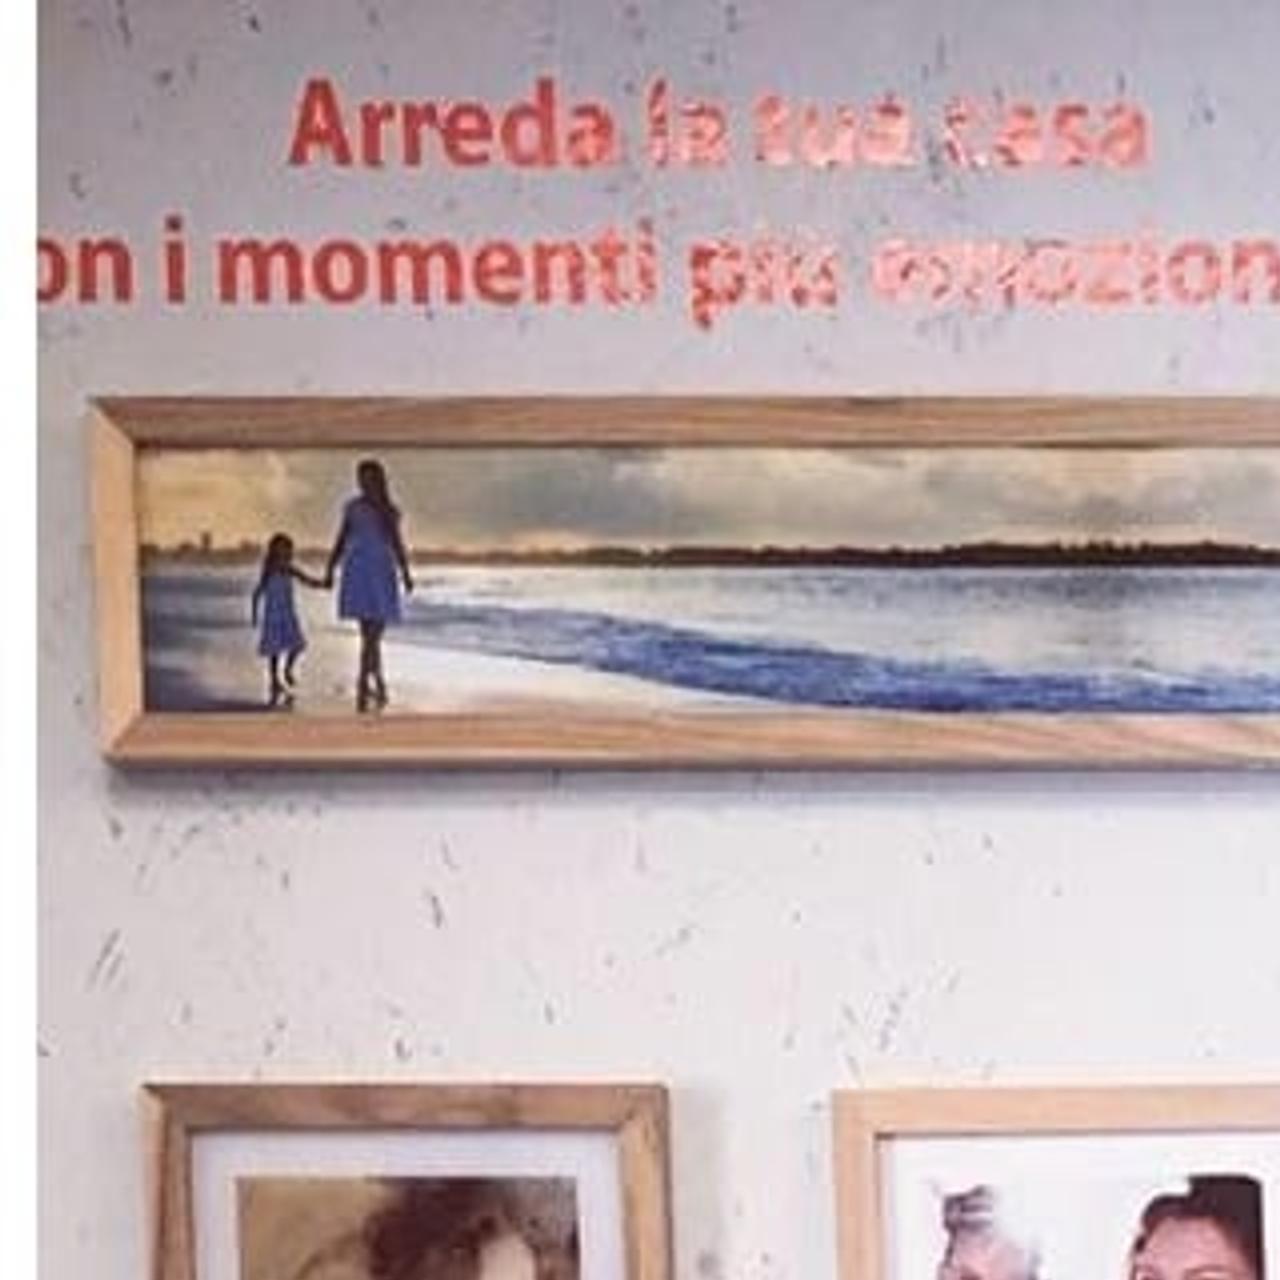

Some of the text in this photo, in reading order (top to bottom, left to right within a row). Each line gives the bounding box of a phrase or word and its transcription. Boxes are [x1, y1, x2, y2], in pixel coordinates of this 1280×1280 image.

[288, 76, 618, 168] Arreda
[643, 78, 732, 168] la
[750, 94, 915, 168] tua
[162, 214, 187, 304] i
[216, 215, 658, 306] momenti
